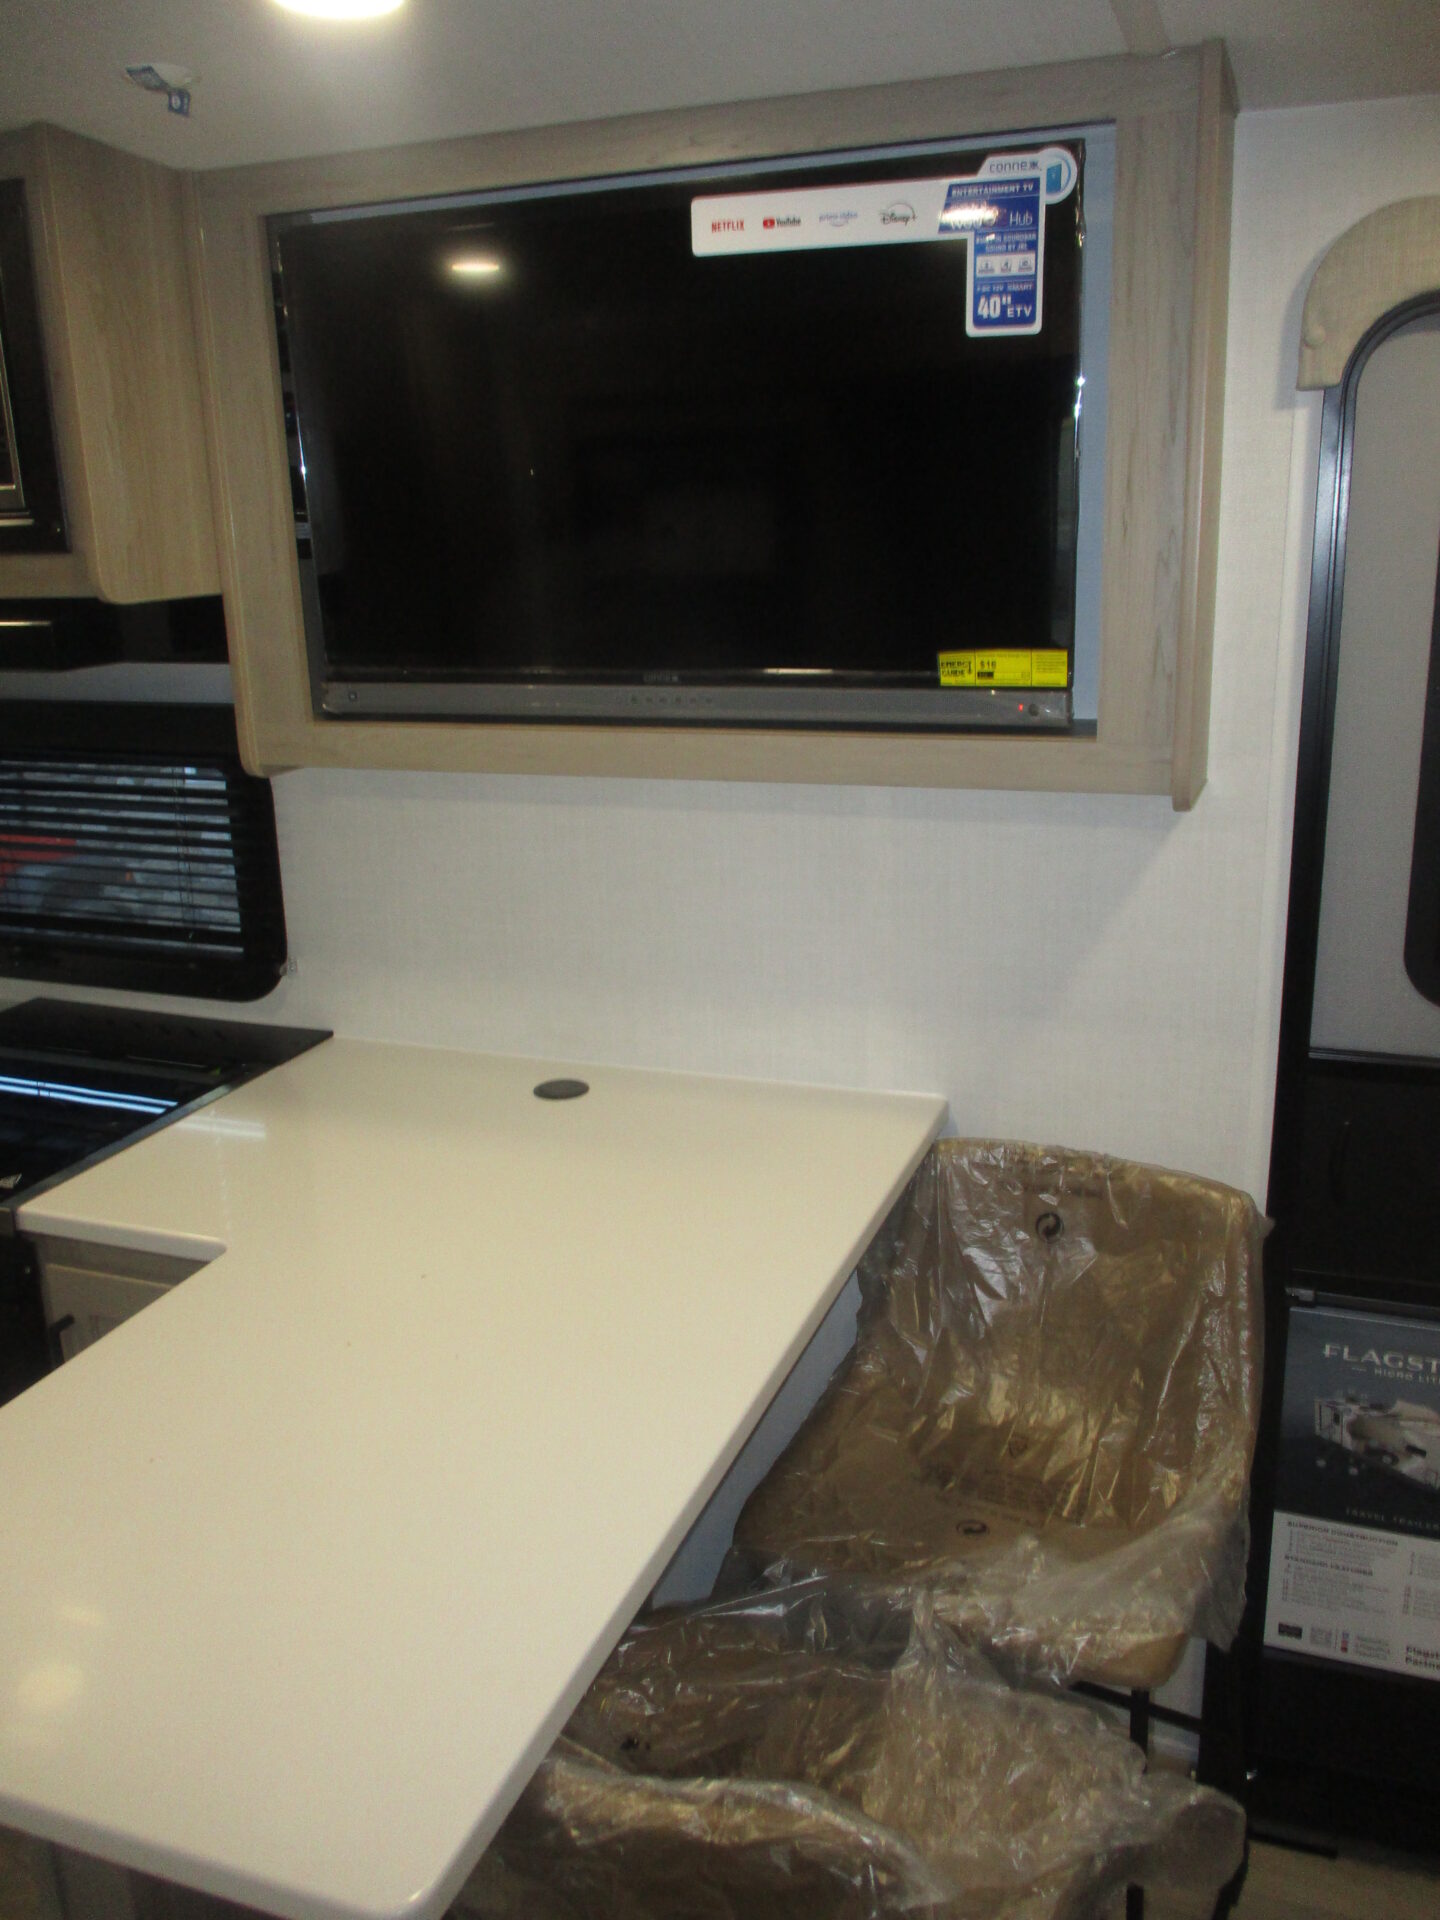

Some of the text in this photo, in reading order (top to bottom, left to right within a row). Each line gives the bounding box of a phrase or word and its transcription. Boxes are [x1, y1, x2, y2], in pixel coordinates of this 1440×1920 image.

[951, 181, 1034, 198] ENTERTAINMENT TV
[711, 218, 745, 233] NETFLIX
[776, 214, 801, 228] YouTube
[1009, 210, 1033, 227] Hub
[977, 293, 1033, 319] 40" ETV
